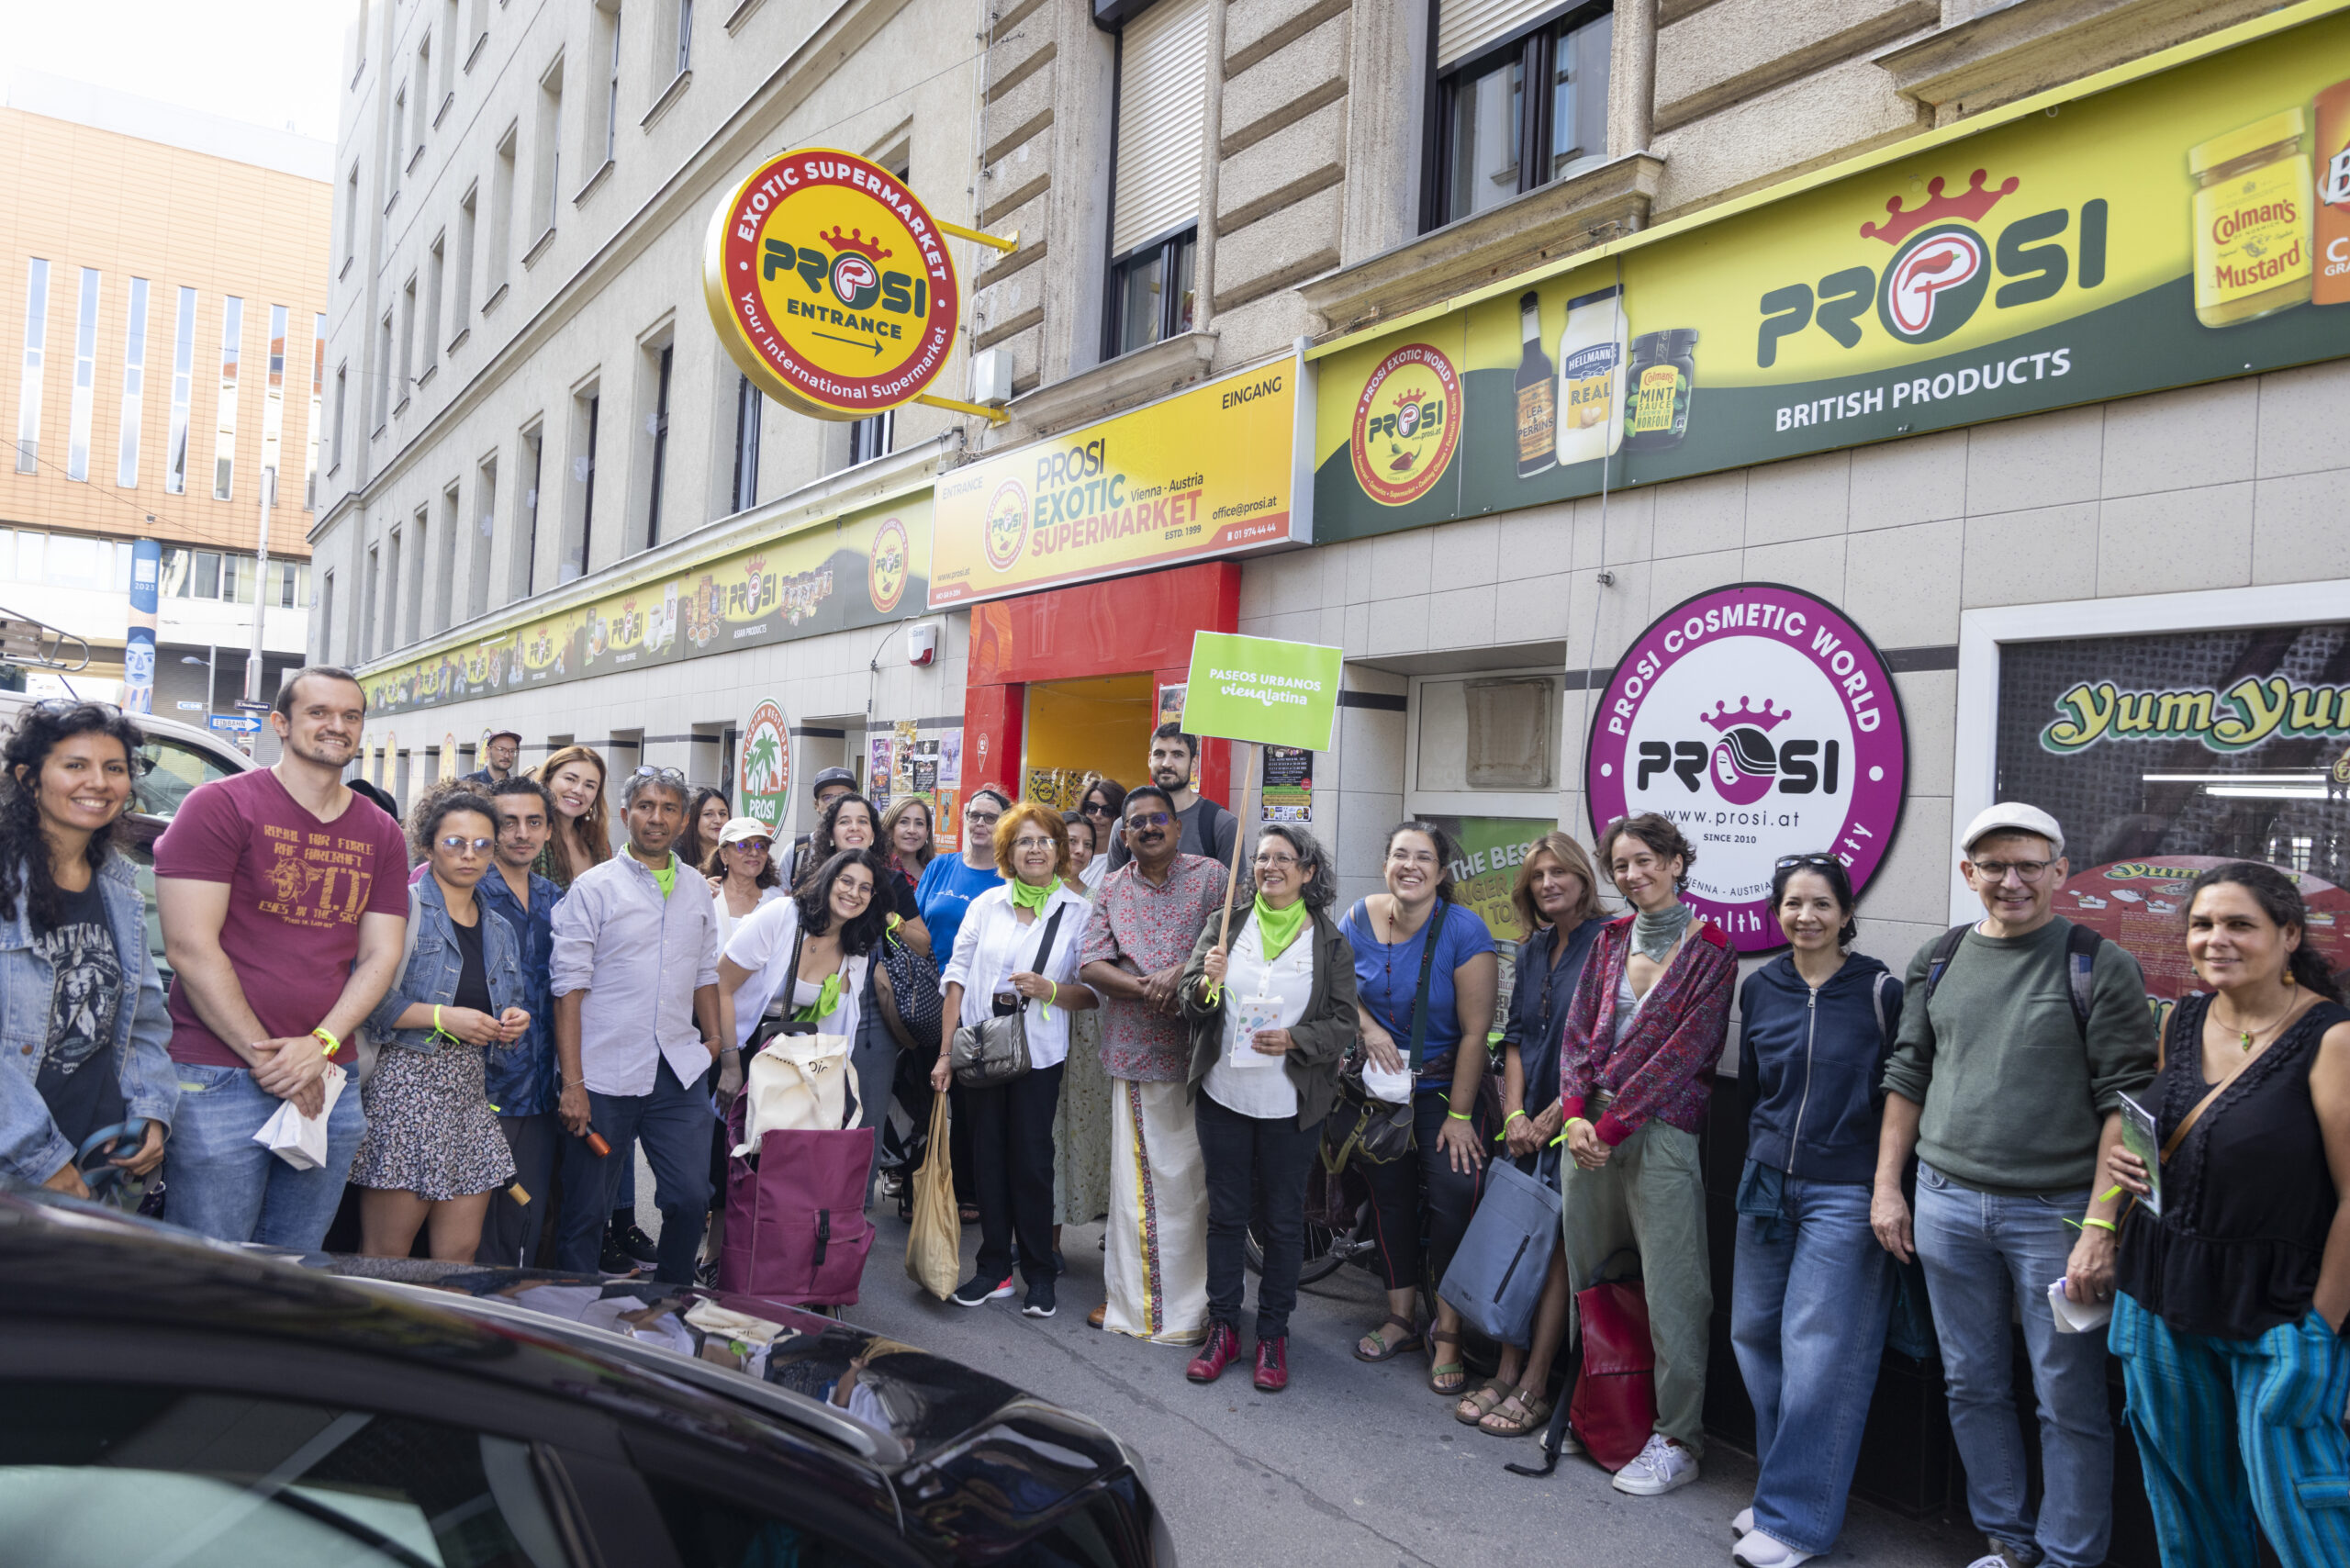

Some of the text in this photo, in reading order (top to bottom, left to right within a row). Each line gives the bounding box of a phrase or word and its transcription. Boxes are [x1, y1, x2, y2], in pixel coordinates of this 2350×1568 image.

[737, 161, 946, 281] EXOTIC SUPERMARKET
[2212, 198, 2297, 245] Colman's
[763, 238, 927, 319] PROSI
[2215, 239, 2300, 289] Mustard
[1757, 198, 2109, 369] PROSI
[787, 297, 902, 340] ENTRANCE
[740, 291, 947, 399] Your International Supermarket
[1363, 349, 1451, 403] PROSI EXOTIC WORLD
[1644, 372, 1673, 386] Colman's
[1774, 348, 2072, 432] BRITISH PRODUCTS
[1222, 375, 1281, 409] EINGANG
[1571, 382, 1610, 406] REAL
[1639, 386, 1674, 403] MINT
[1639, 400, 1672, 410] SAUCE
[1369, 399, 1443, 443] PROSI
[1527, 404, 1542, 419] LEA
[1637, 415, 1670, 429] NORFOLK
[1517, 417, 1553, 438] PERRINS
[1035, 438, 1105, 493] PROSI
[942, 476, 983, 500] ENTRANCE
[1034, 474, 1126, 529] EXOTIC
[1130, 485, 1162, 502] Vienna
[1169, 472, 1203, 492] Austria
[1031, 489, 1203, 557] SUPERMARKET
[1212, 496, 1277, 520] office@prosi.at
[1165, 524, 1202, 541] ESTD. 1999
[1234, 522, 1276, 540] 01 974 44 44
[937, 567, 970, 581] www.prosi.at
[729, 572, 777, 615] PROSI
[611, 610, 643, 644] PROSI
[746, 624, 767, 637] PRODUCTS
[1209, 668, 1322, 691] PASEOS URBANOS
[1607, 603, 1882, 736] PROSI COSMETIC WORLD
[216, 719, 246, 727] EINBAHN
[745, 708, 789, 788] INDIAN RESTAURANT
[1637, 728, 1840, 805] PROSI
[749, 799, 776, 820] PROSI
[1663, 808, 1800, 827] www.prosi.at
[264, 824, 375, 856] ROYAL AIR FORCE
[1703, 834, 1757, 844] SINCE 2010
[274, 842, 363, 868] RAF AIRCRAFT
[1447, 843, 1531, 882] THE BES
[1730, 881, 1773, 897] AUSTRIA
[258, 900, 358, 925] EYES IN THE SKY
